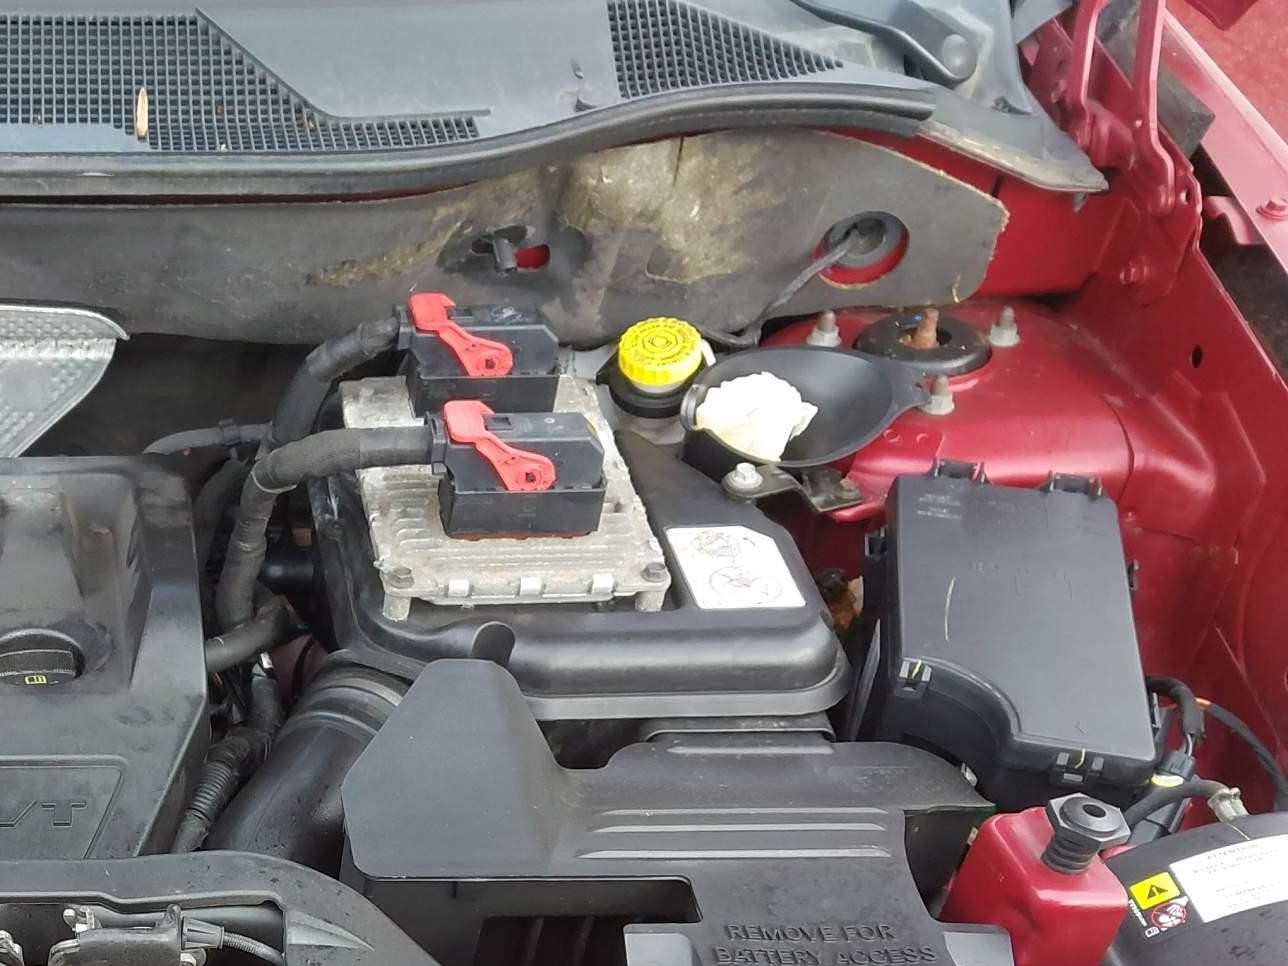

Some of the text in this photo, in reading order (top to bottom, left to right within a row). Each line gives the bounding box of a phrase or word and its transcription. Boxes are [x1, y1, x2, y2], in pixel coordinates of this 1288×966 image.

[726, 924, 895, 943] REMOVE FOR
[714, 946, 937, 966] BATTERY ACCESS
